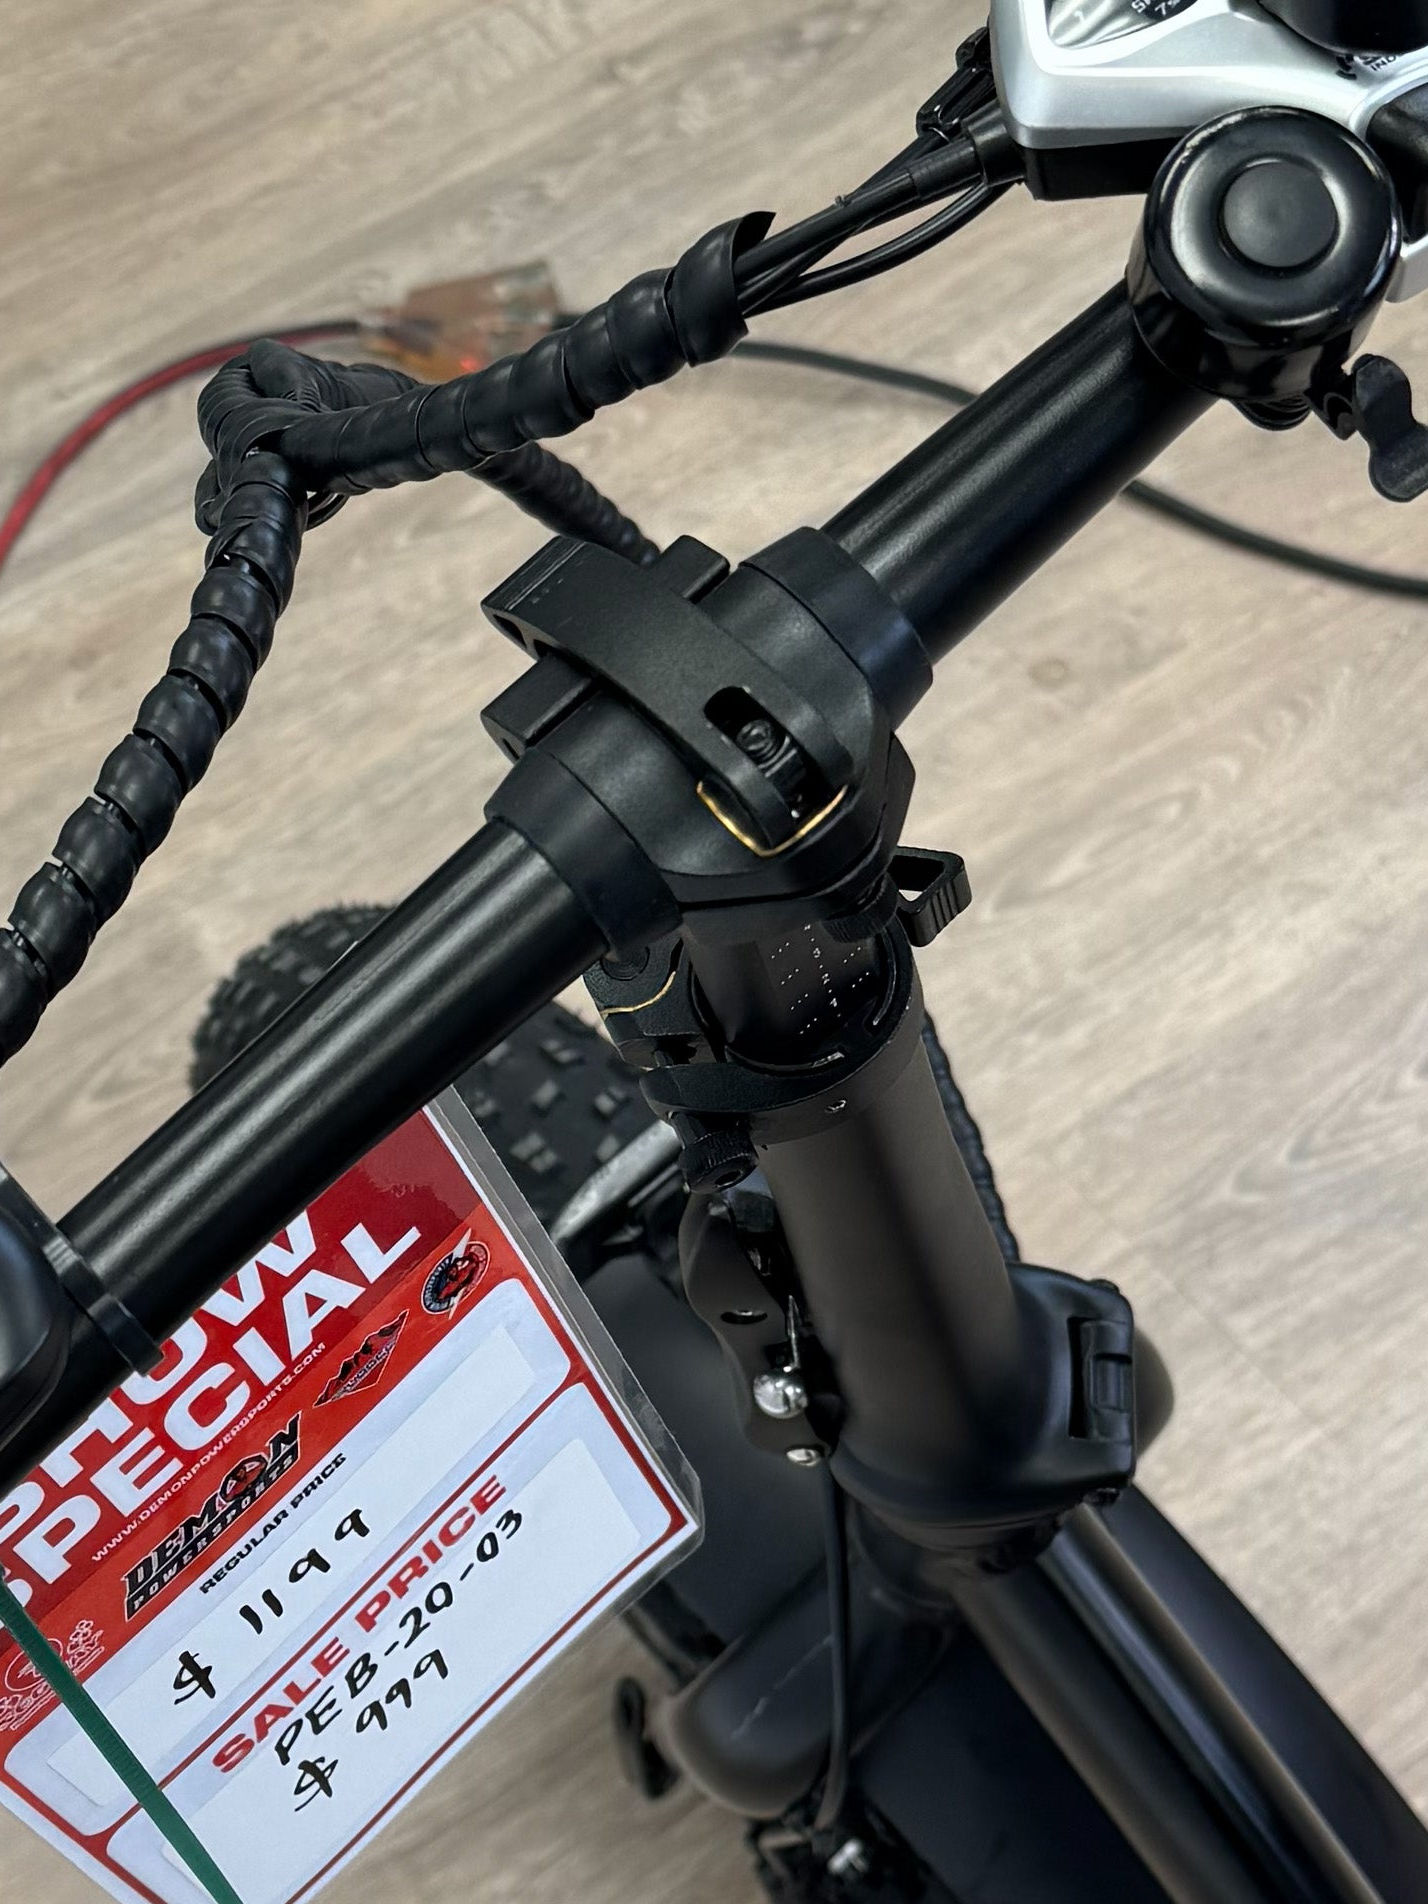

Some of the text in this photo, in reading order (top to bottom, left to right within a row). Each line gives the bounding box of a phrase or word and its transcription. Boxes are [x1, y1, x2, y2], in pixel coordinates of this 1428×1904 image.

[91, 1341, 326, 1563] WWW.DEMONPOWERSPORTS.COM
[132, 1455, 295, 1610] POWERSPORTS
[199, 1452, 347, 1595] REGULAR PRICE
[173, 1650, 217, 1705] $
[239, 1509, 370, 1635] 1199
[212, 1637, 351, 1774] SALE
[354, 1474, 507, 1633] PRICE
[274, 1509, 523, 1766] PEB-20-03
[293, 1649, 449, 1812] $ 999
